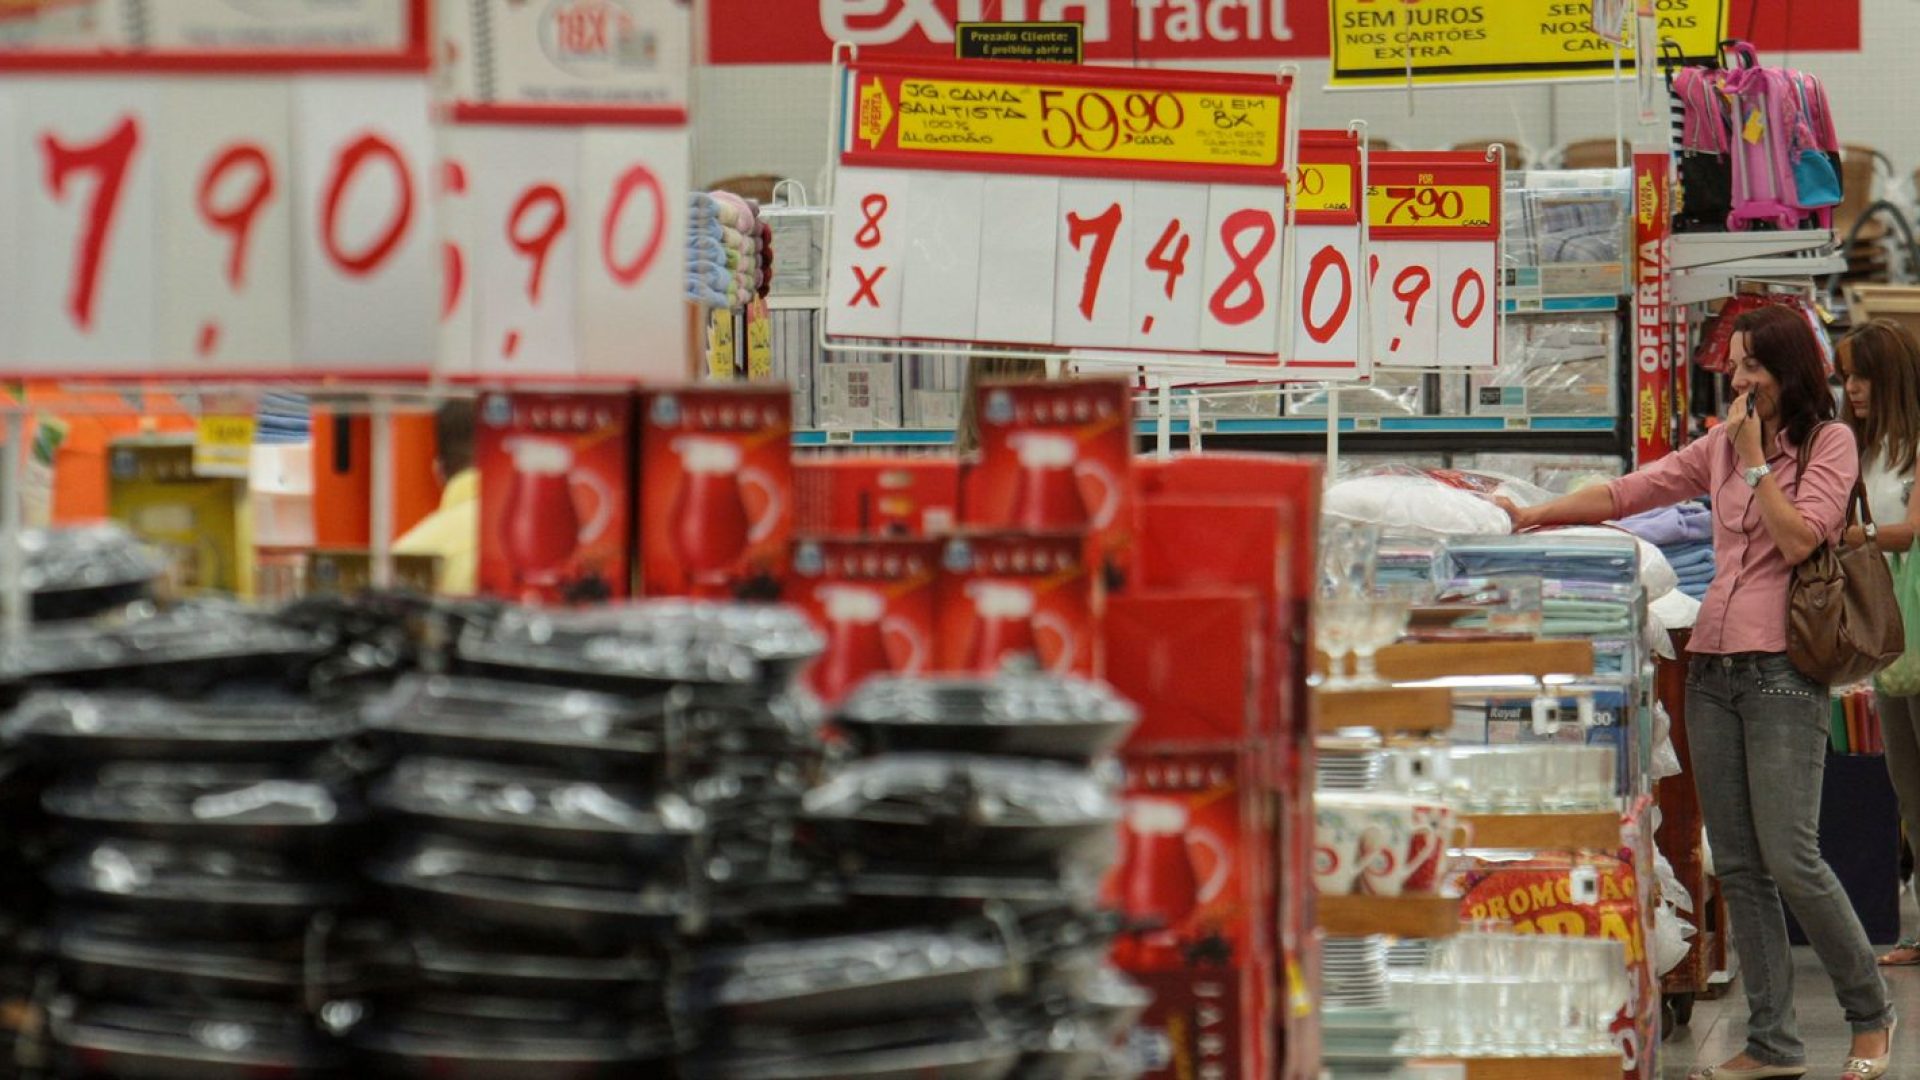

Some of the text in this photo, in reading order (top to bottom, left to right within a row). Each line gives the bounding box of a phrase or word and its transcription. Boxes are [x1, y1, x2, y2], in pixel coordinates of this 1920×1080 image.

[1344, 11, 1395, 29] SEM
[970, 31, 1017, 42] Prezado
[1346, 28, 1487, 45] NOS CARTÕES
[1375, 46, 1453, 59] EXTRA
[949, 88, 1022, 103] CAMA
[1199, 98, 1265, 110] OU EM
[871, 91, 883, 136] OFERTA
[899, 102, 1027, 119] SANTISTA
[1039, 90, 1185, 152] 59,90
[902, 131, 994, 144] ALGODÃO
[1134, 133, 1175, 146] CADA
[1418, 173, 1434, 185] POR
[854, 193, 888, 250] 8
[1067, 202, 1276, 335] 7,48
[847, 265, 887, 308] X
[1638, 239, 1660, 373] OFERTA
